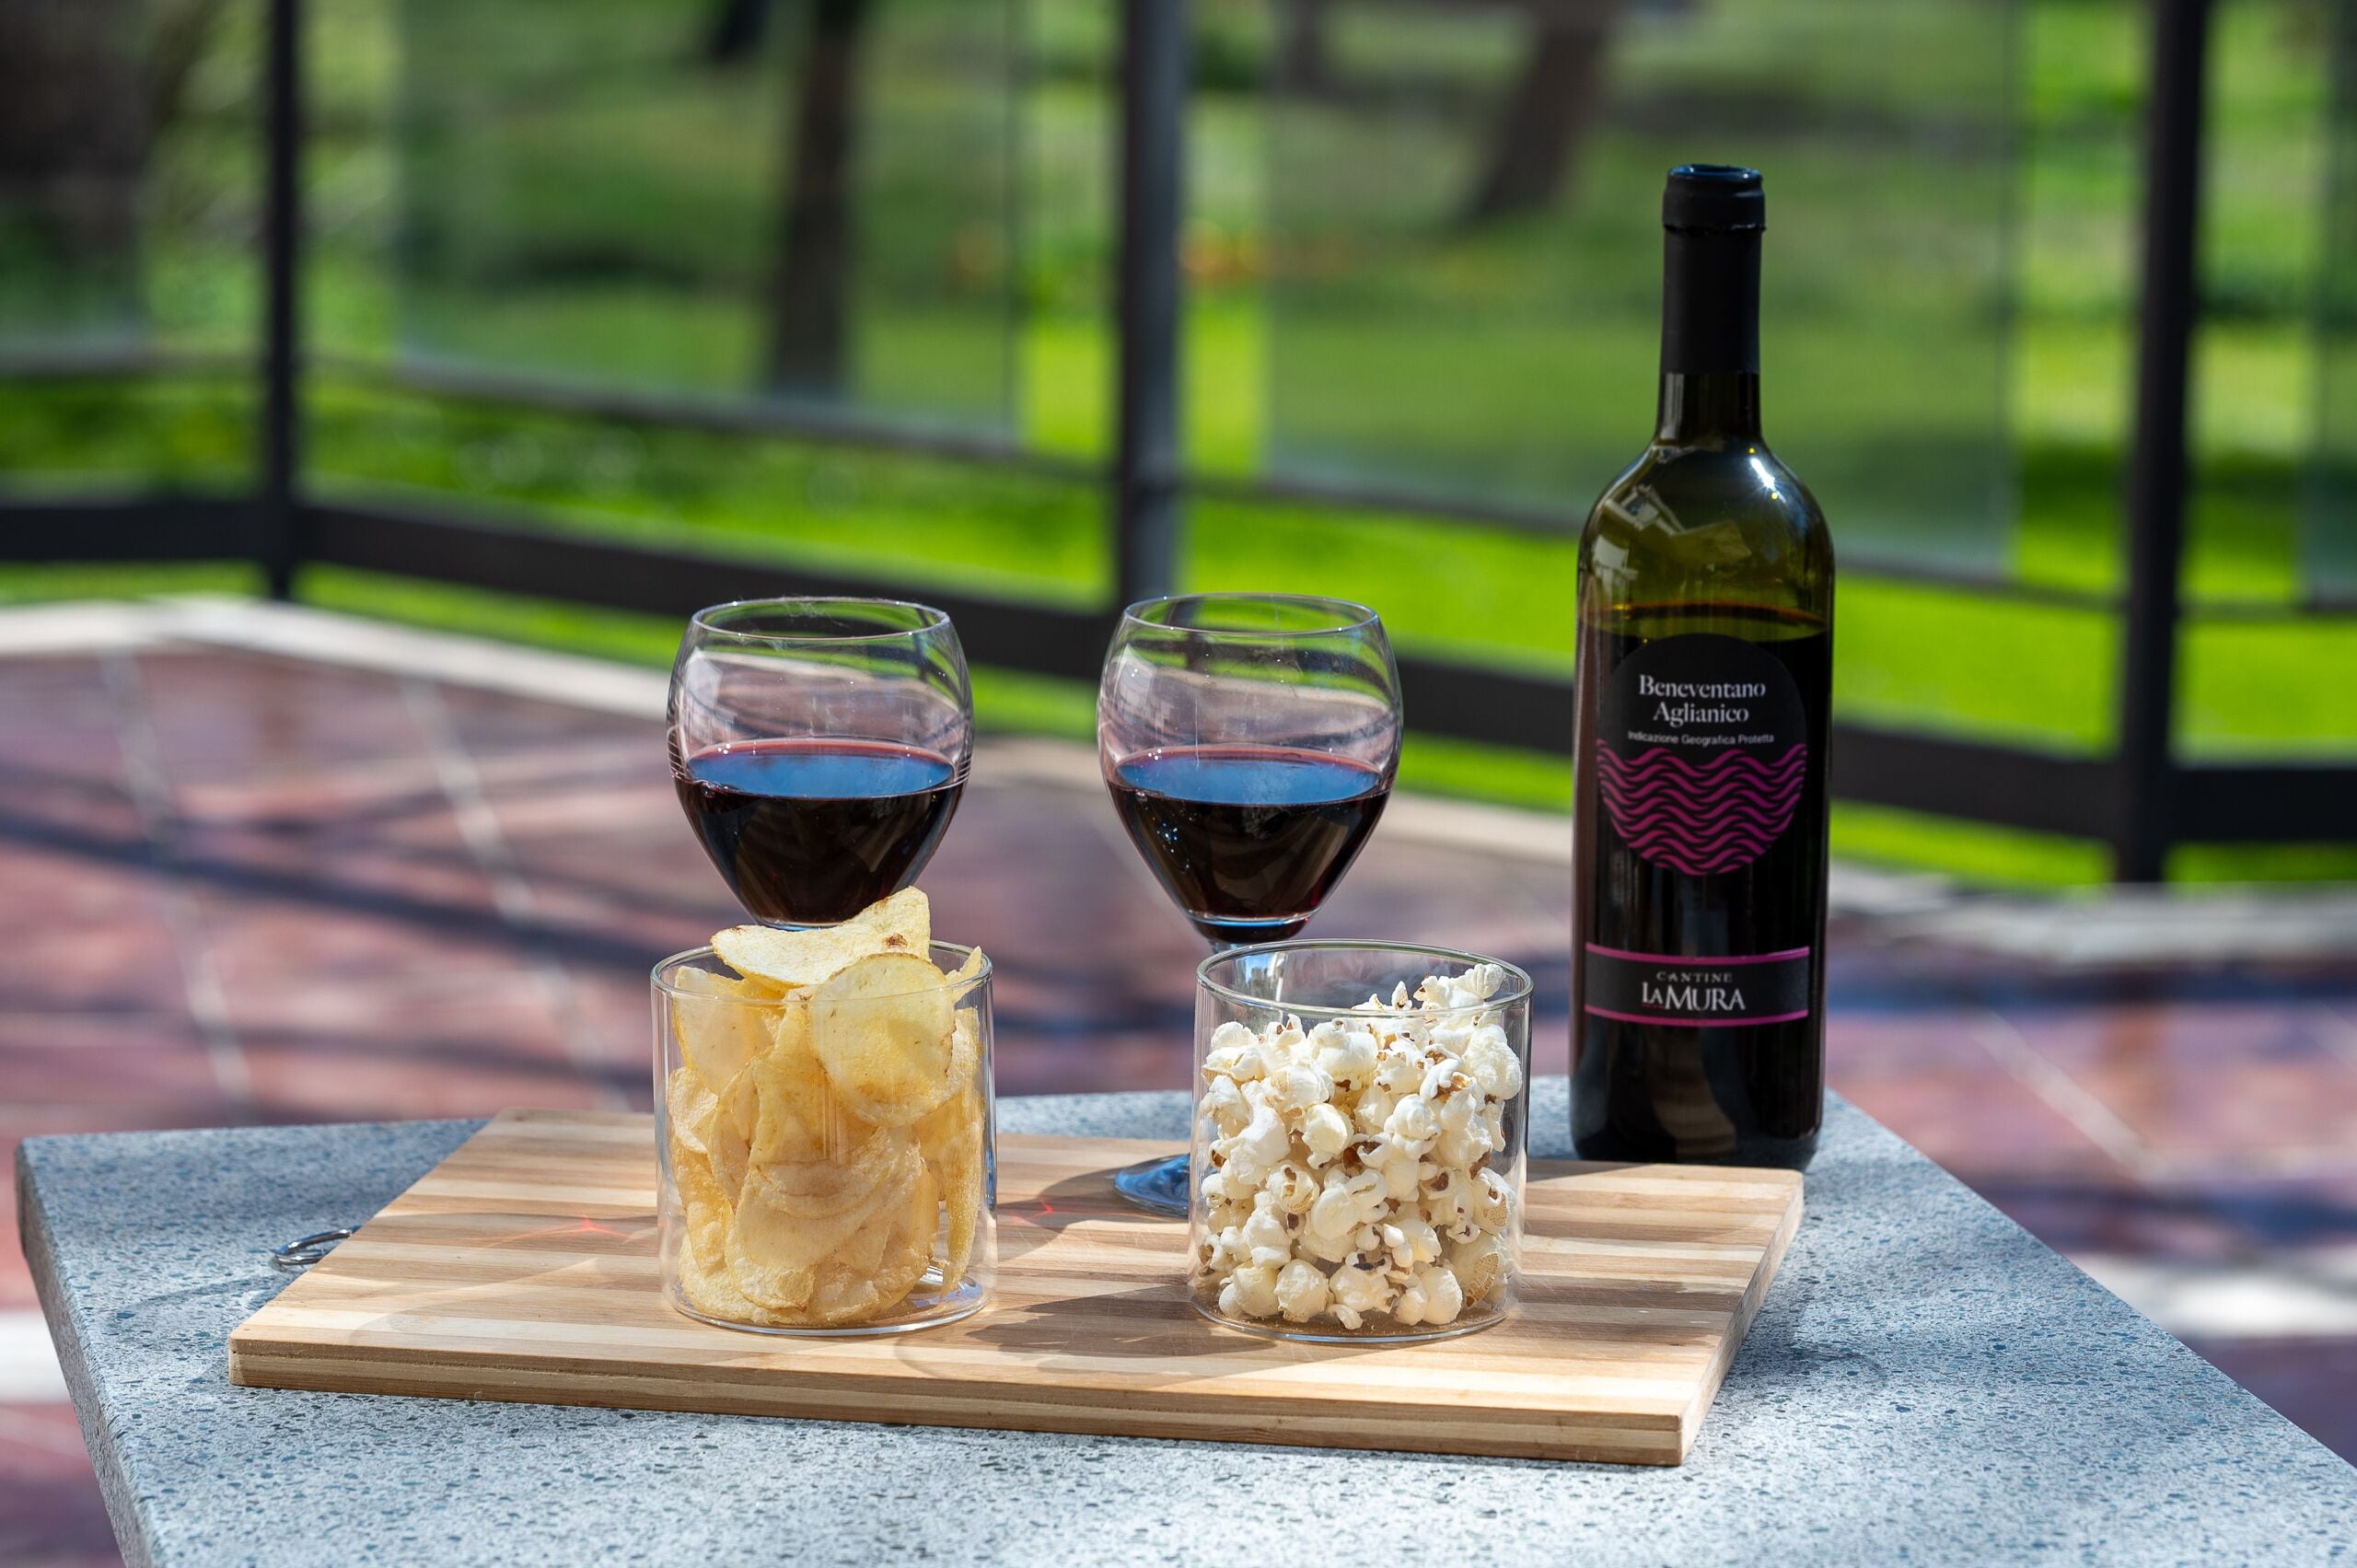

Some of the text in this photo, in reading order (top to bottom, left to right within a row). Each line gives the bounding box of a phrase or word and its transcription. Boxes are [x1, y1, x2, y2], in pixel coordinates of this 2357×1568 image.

[1639, 674, 1766, 698] Beneventano
[1653, 702, 1749, 727] Aglianico
[1628, 730, 1774, 747] Indicazione Geografica Protetta
[1656, 970, 1733, 982] CANTINE
